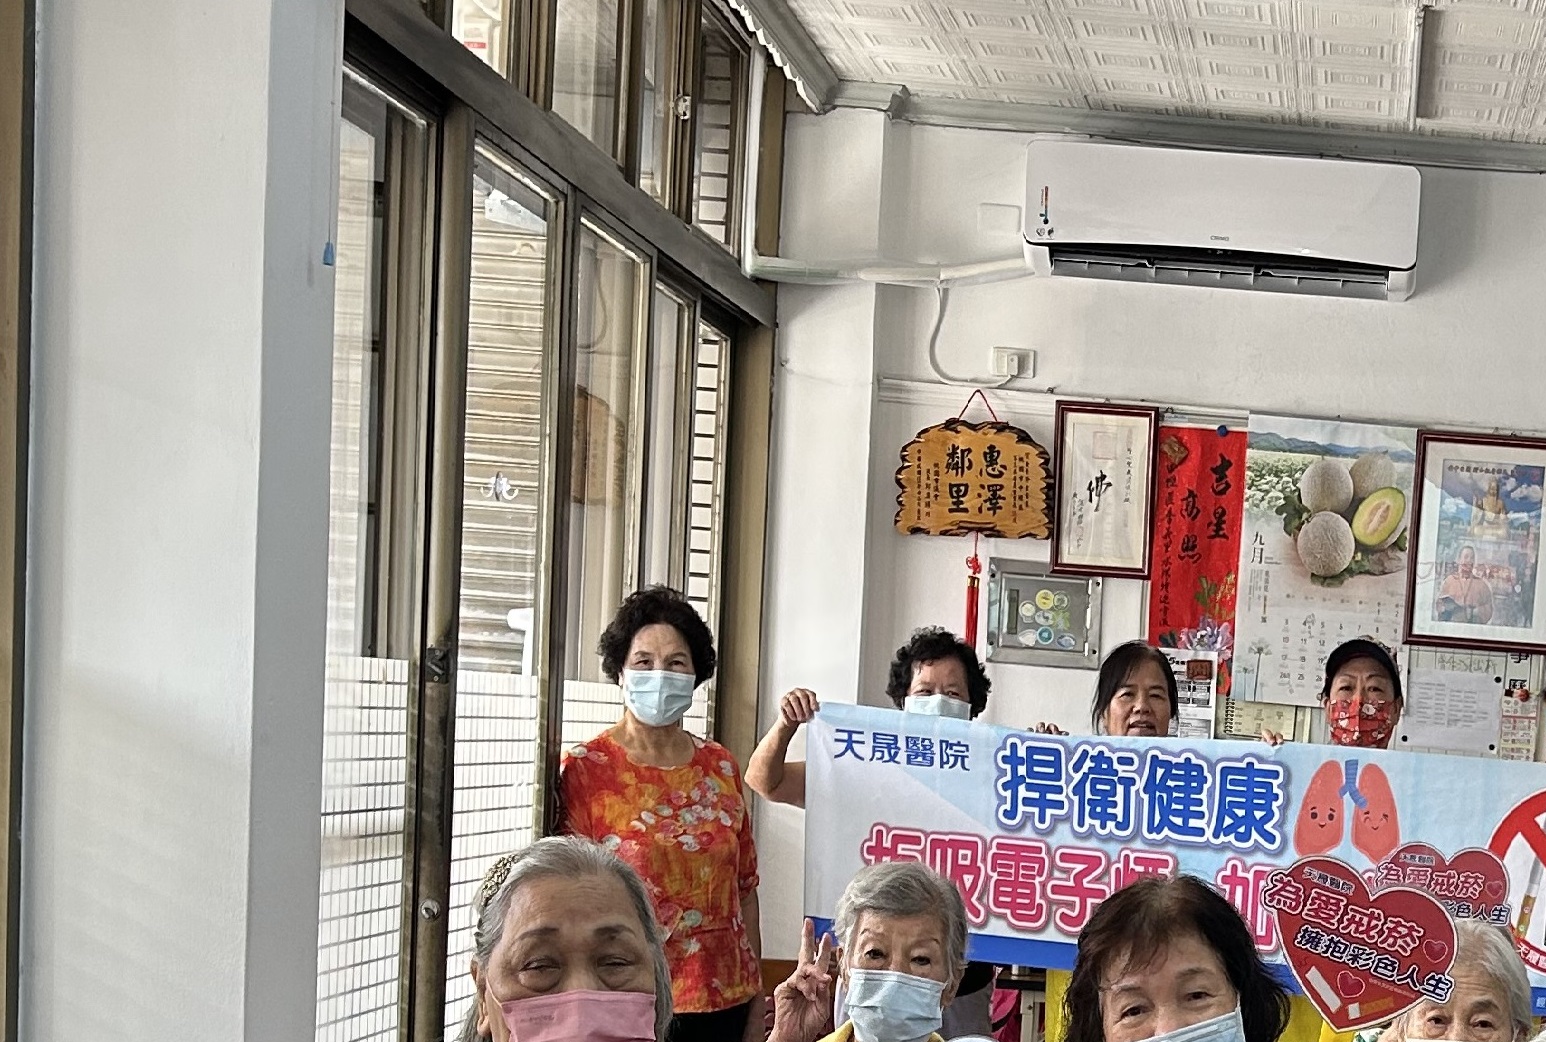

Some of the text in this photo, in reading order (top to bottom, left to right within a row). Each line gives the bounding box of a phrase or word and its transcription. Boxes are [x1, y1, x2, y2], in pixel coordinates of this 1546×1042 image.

[977, 444, 1007, 516] 惠澤
[1207, 453, 1233, 540] 吉星
[1178, 488, 1203, 564] 高照
[1251, 531, 1265, 565] 九月
[834, 728, 970, 771] 天晟醫院
[999, 739, 1283, 848] 捍衛健康
[864, 825, 1175, 932] 吸電子
[1265, 872, 1425, 956] 為愛戒菸
[1295, 927, 1454, 1003] 擁抱彩色人生
